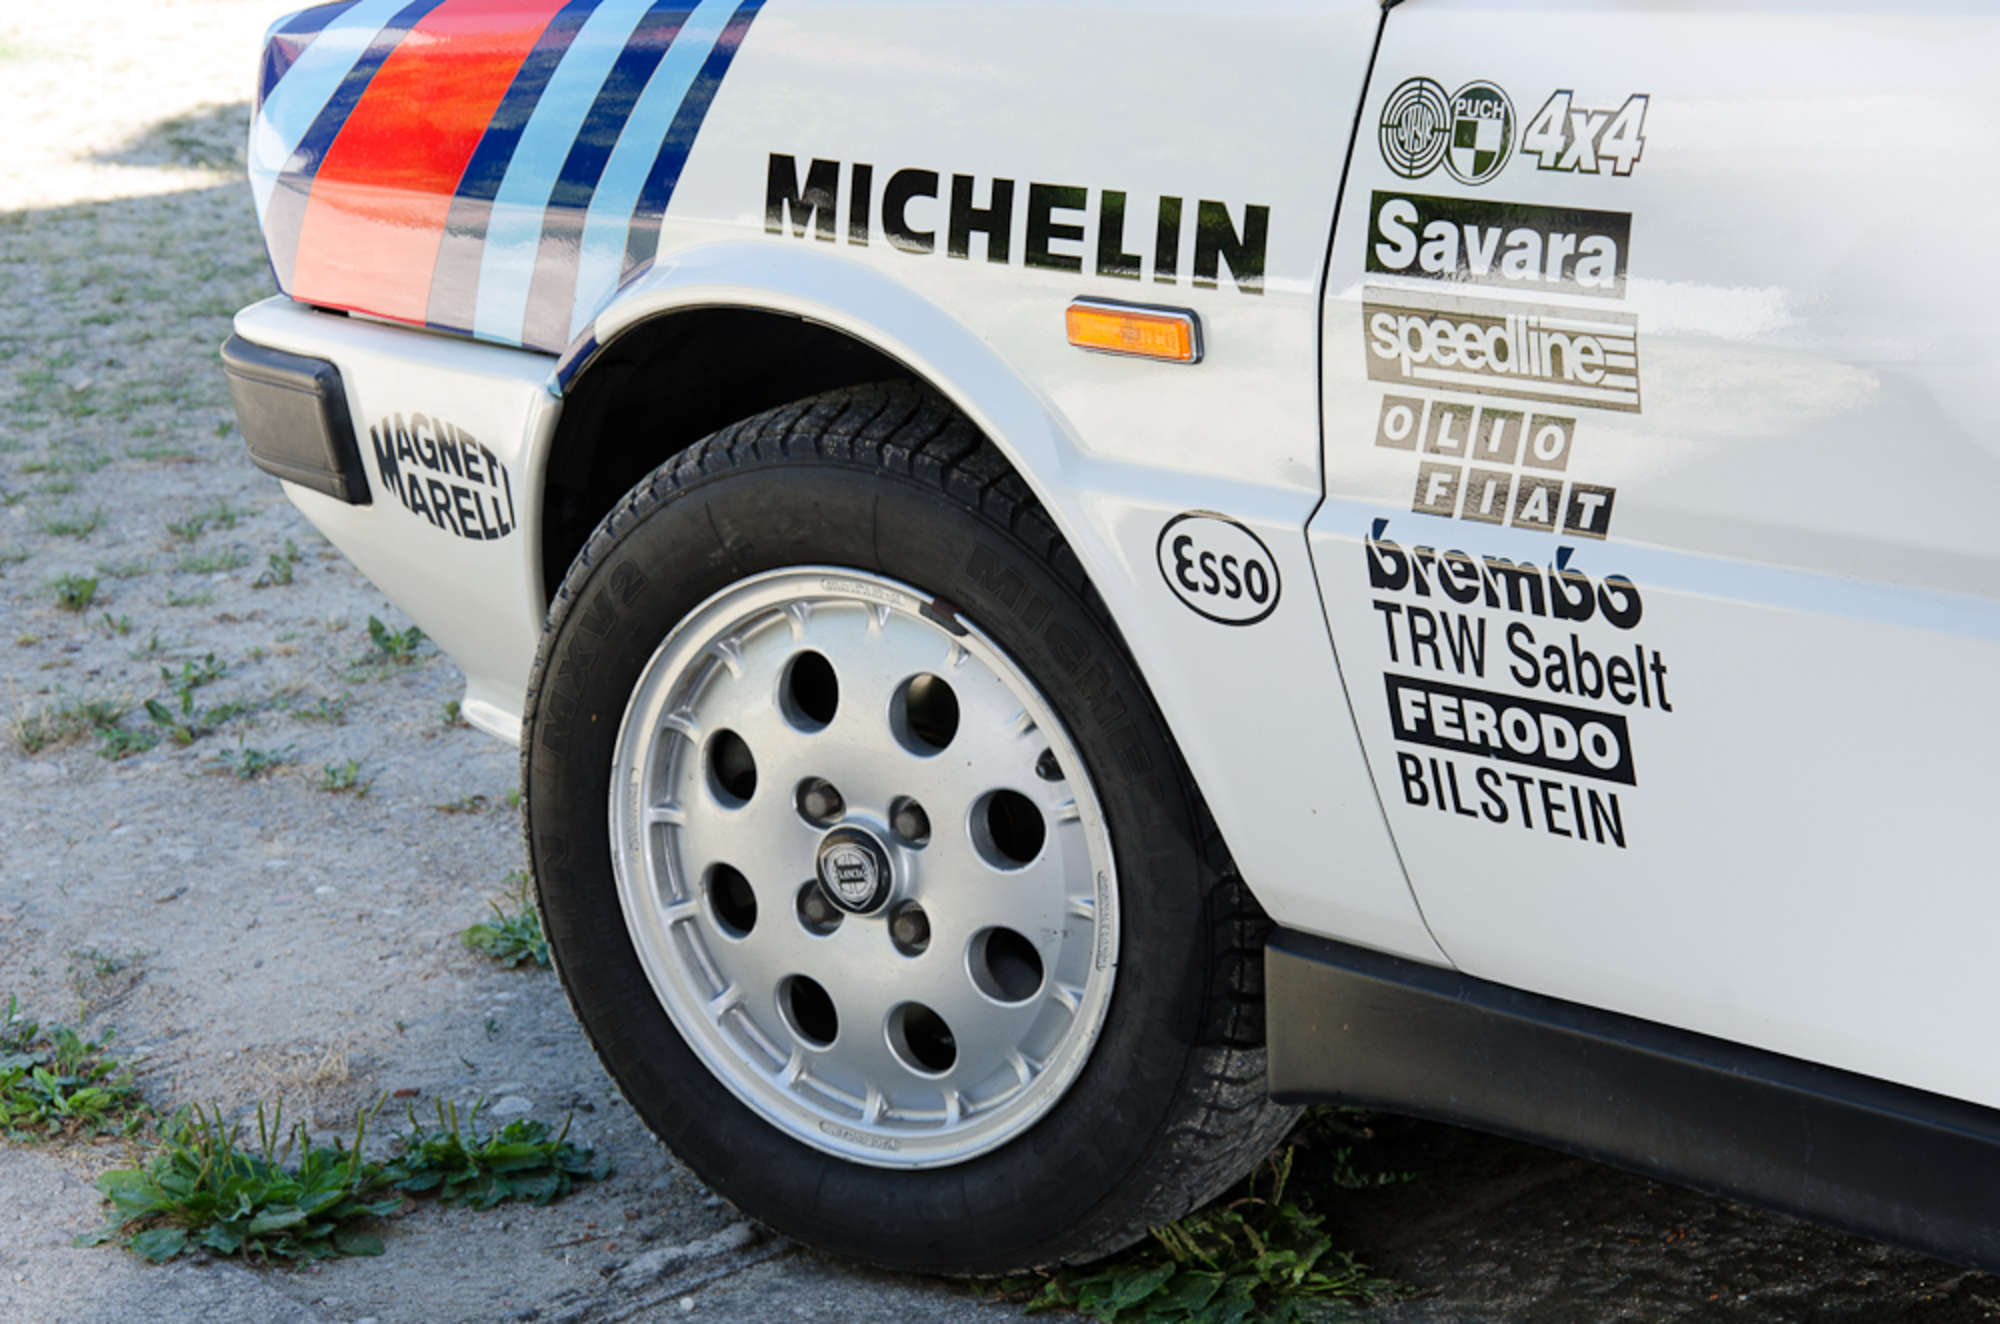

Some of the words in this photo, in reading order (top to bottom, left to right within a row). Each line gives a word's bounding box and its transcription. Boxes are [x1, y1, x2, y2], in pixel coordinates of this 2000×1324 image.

[1456, 97, 1506, 120] PUCH
[1520, 88, 1651, 177] 4x4
[764, 152, 1270, 295] MICHELIN
[1375, 198, 1617, 289] Savara
[1370, 312, 1607, 385] speedline
[370, 411, 512, 490] MAGNETI
[1383, 406, 1566, 462] OLIO
[379, 460, 516, 541] MARELLI
[1425, 473, 1605, 529] FIAT
[1365, 517, 1643, 630] brembo
[1373, 599, 1487, 679] TRW
[1506, 621, 1673, 713] Sabelt
[1397, 687, 1622, 771] FERODO
[1396, 751, 1627, 848] BILSTEIN
